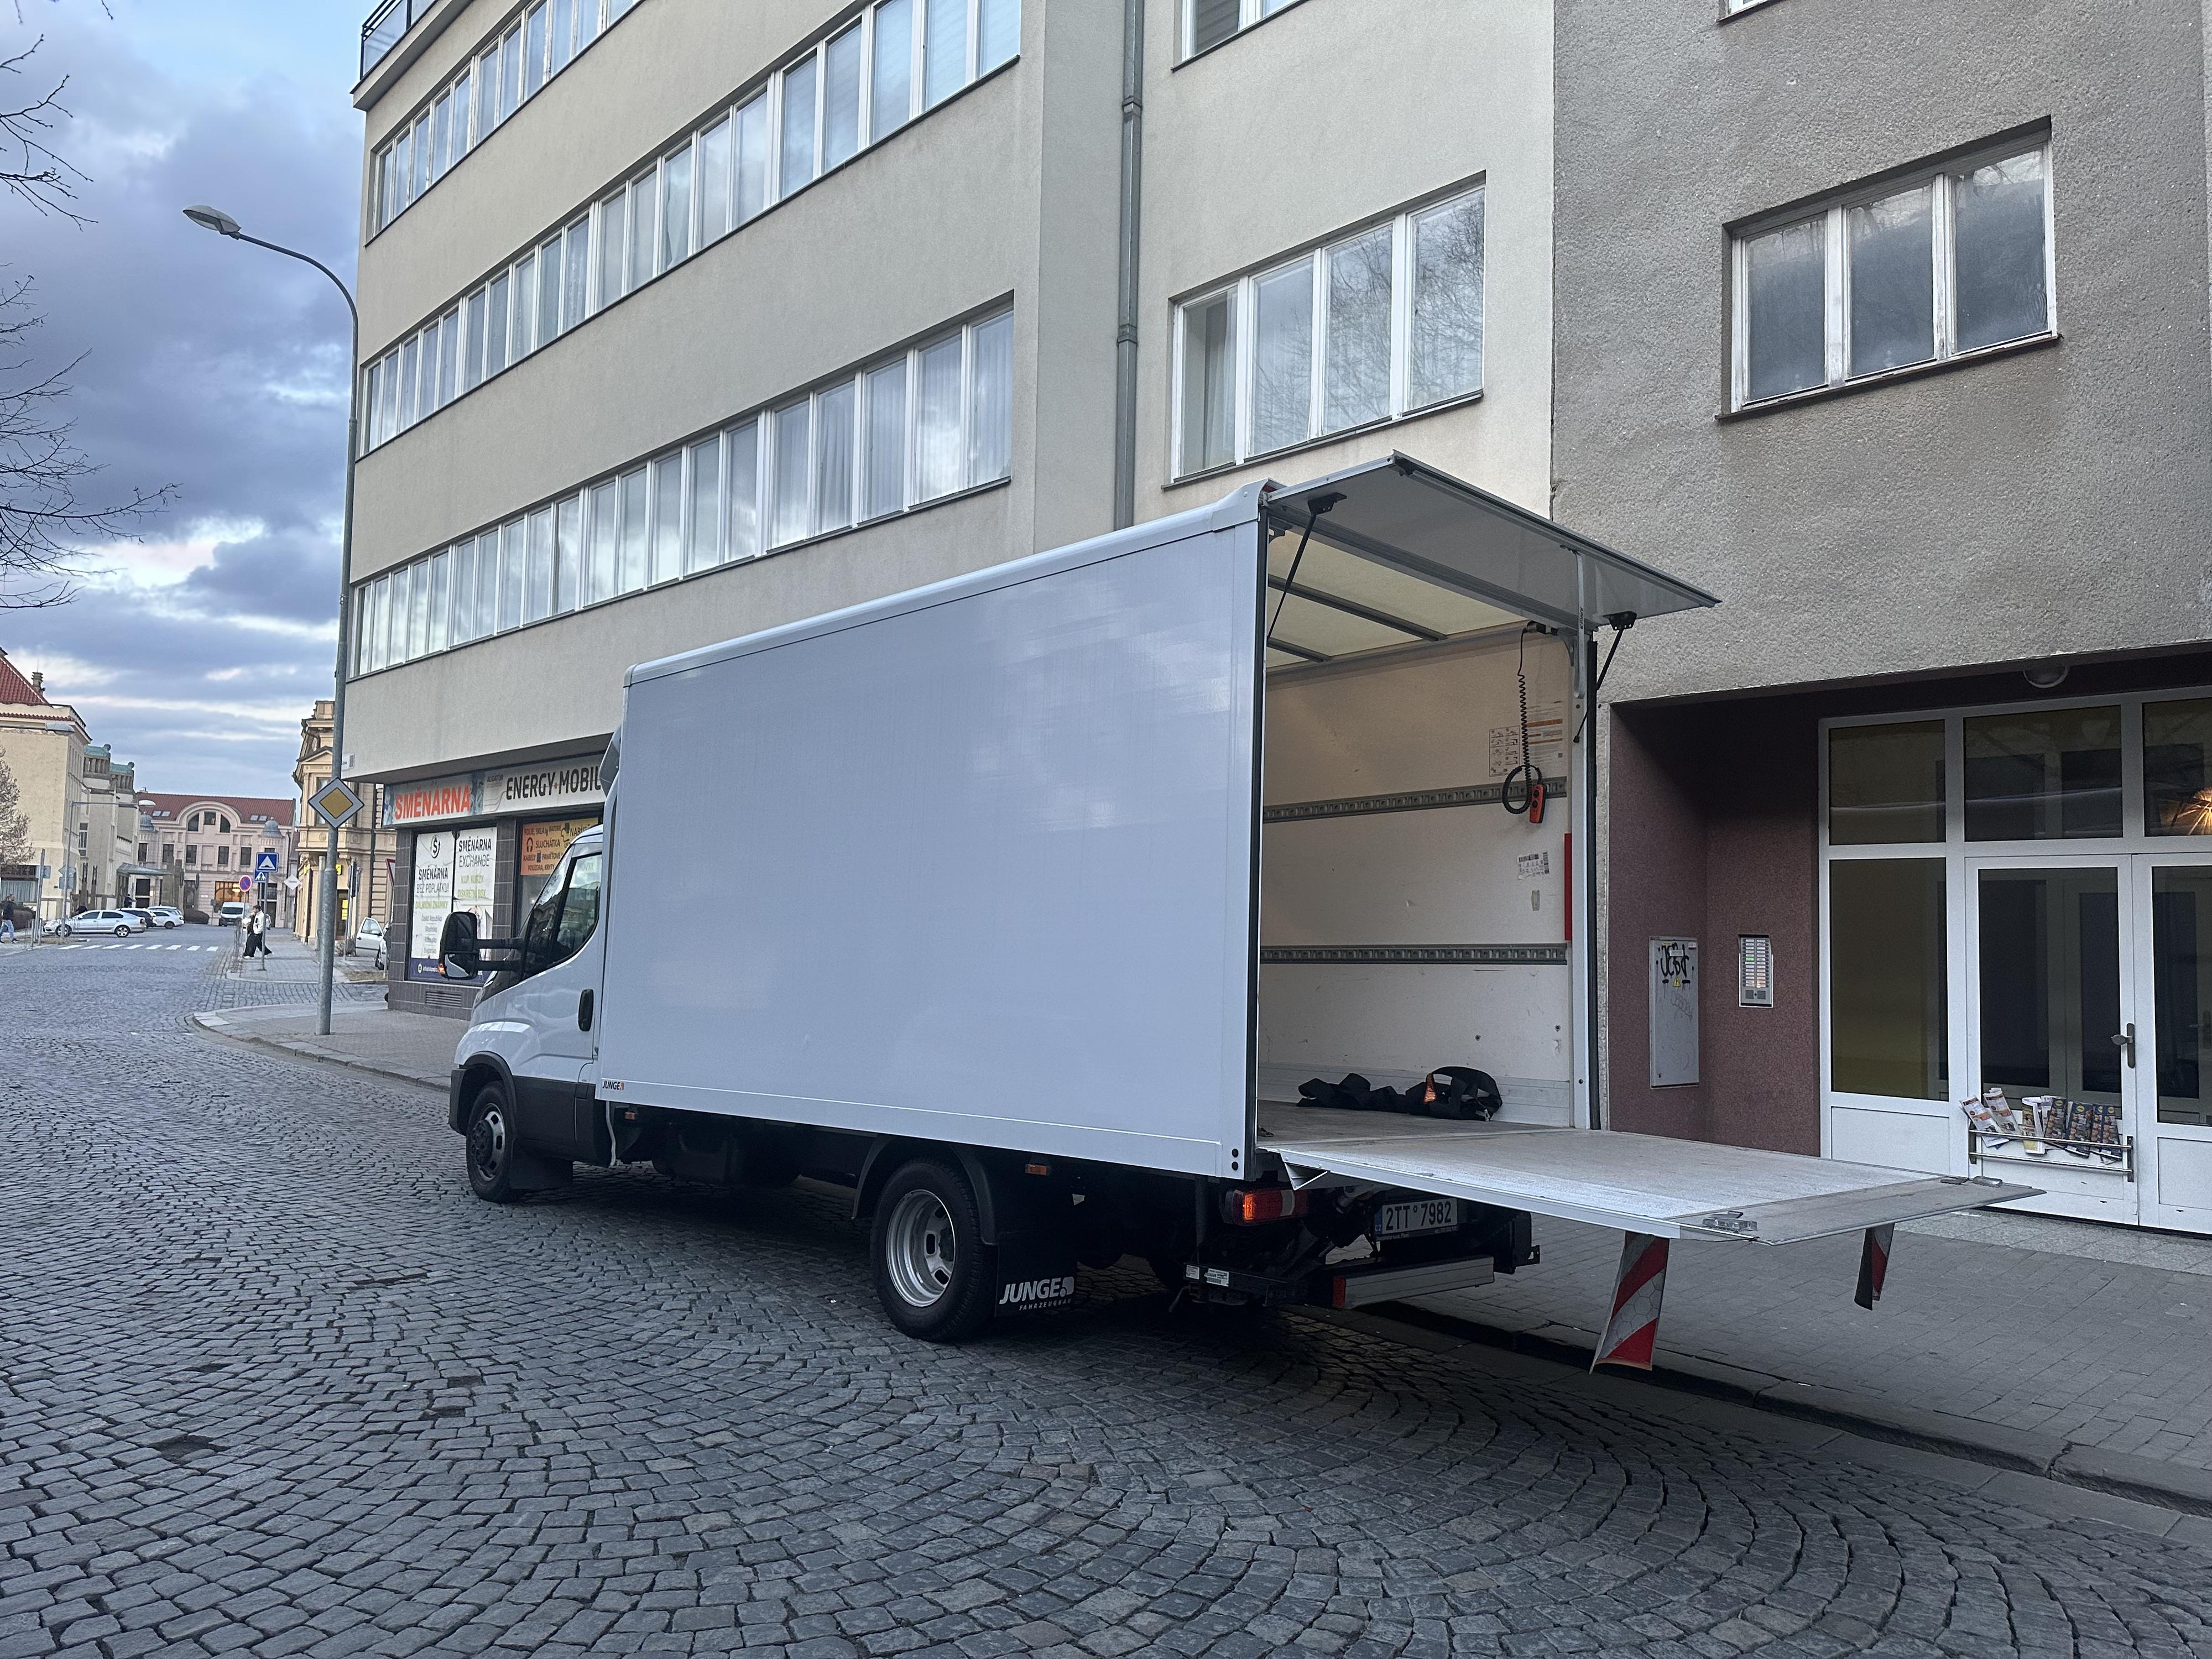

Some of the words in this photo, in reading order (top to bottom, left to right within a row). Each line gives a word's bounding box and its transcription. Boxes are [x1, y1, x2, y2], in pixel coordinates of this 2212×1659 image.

[506, 772, 556, 800] ENERGY
[394, 785, 471, 820] SMĚNÁRNA
[458, 835, 492, 852] SMĚNÁRNA
[535, 837, 561, 849] SLUCHÁTKA
[459, 854, 490, 868] EXCHANGE
[602, 1081, 620, 1090] JUNGE
[1386, 1205, 1410, 1231] 2TT
[1421, 1201, 1452, 1227] 7982
[999, 1277, 1062, 1305] JUNGE
[1019, 1298, 1072, 1311] FAHRZEUGBAU
